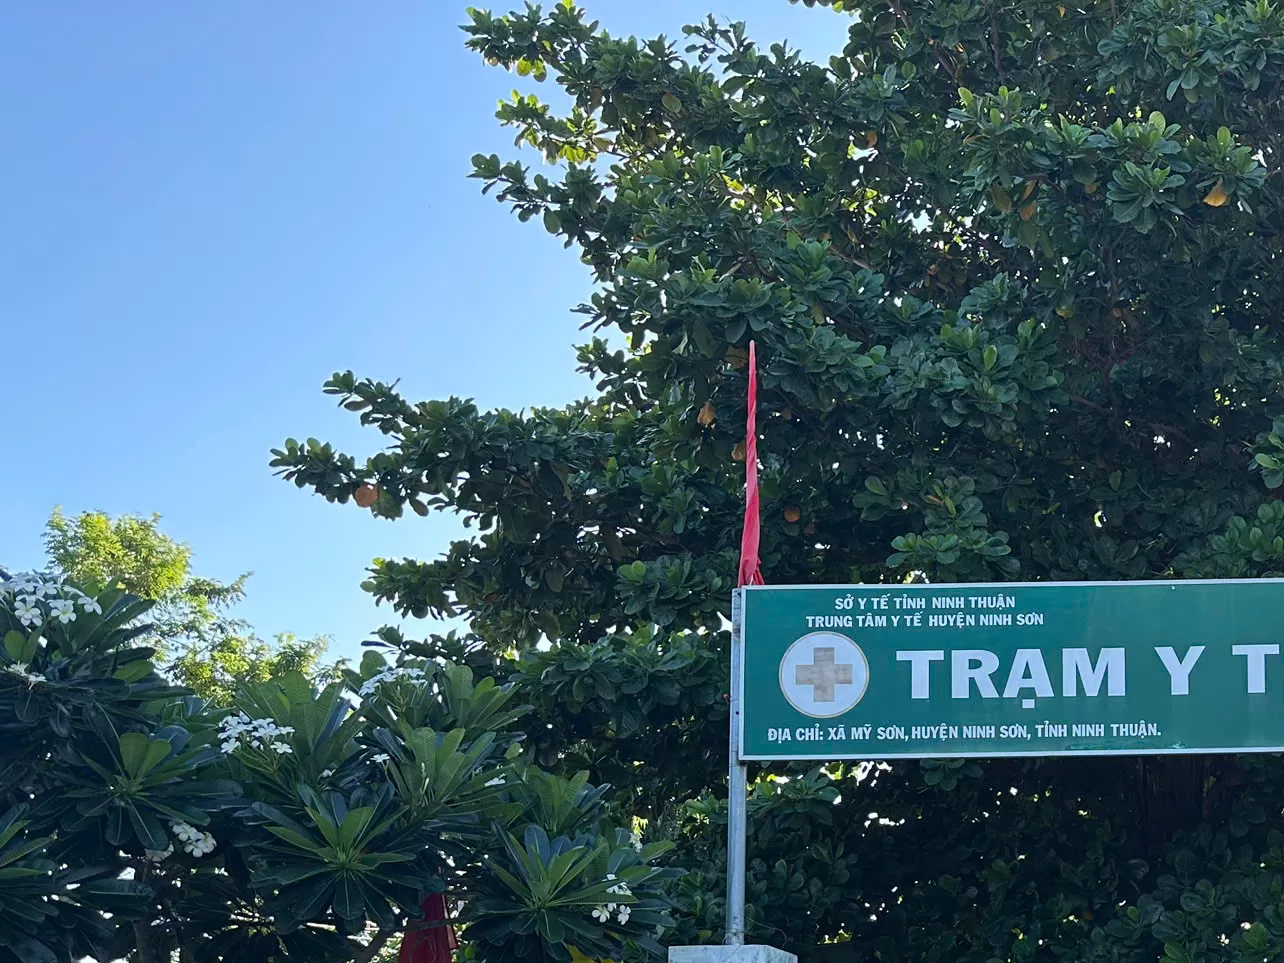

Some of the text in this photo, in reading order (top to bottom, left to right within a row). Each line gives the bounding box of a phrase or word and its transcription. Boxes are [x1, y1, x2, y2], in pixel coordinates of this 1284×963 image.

[834, 593, 1016, 611] SỞ Y TẾ TỈNH NINH THUẬN
[806, 611, 1044, 629] TRUNG TÂM Y TẾ HUYỆN NINH SƠN
[896, 647, 1127, 709] TRẠM
[1155, 645, 1206, 695] Y
[768, 720, 1162, 744] ĐỊA CHỈ: XÃ MỸ SƠN, HUYỆN NINH SƠN, TỈNH NINH THUẬN.
